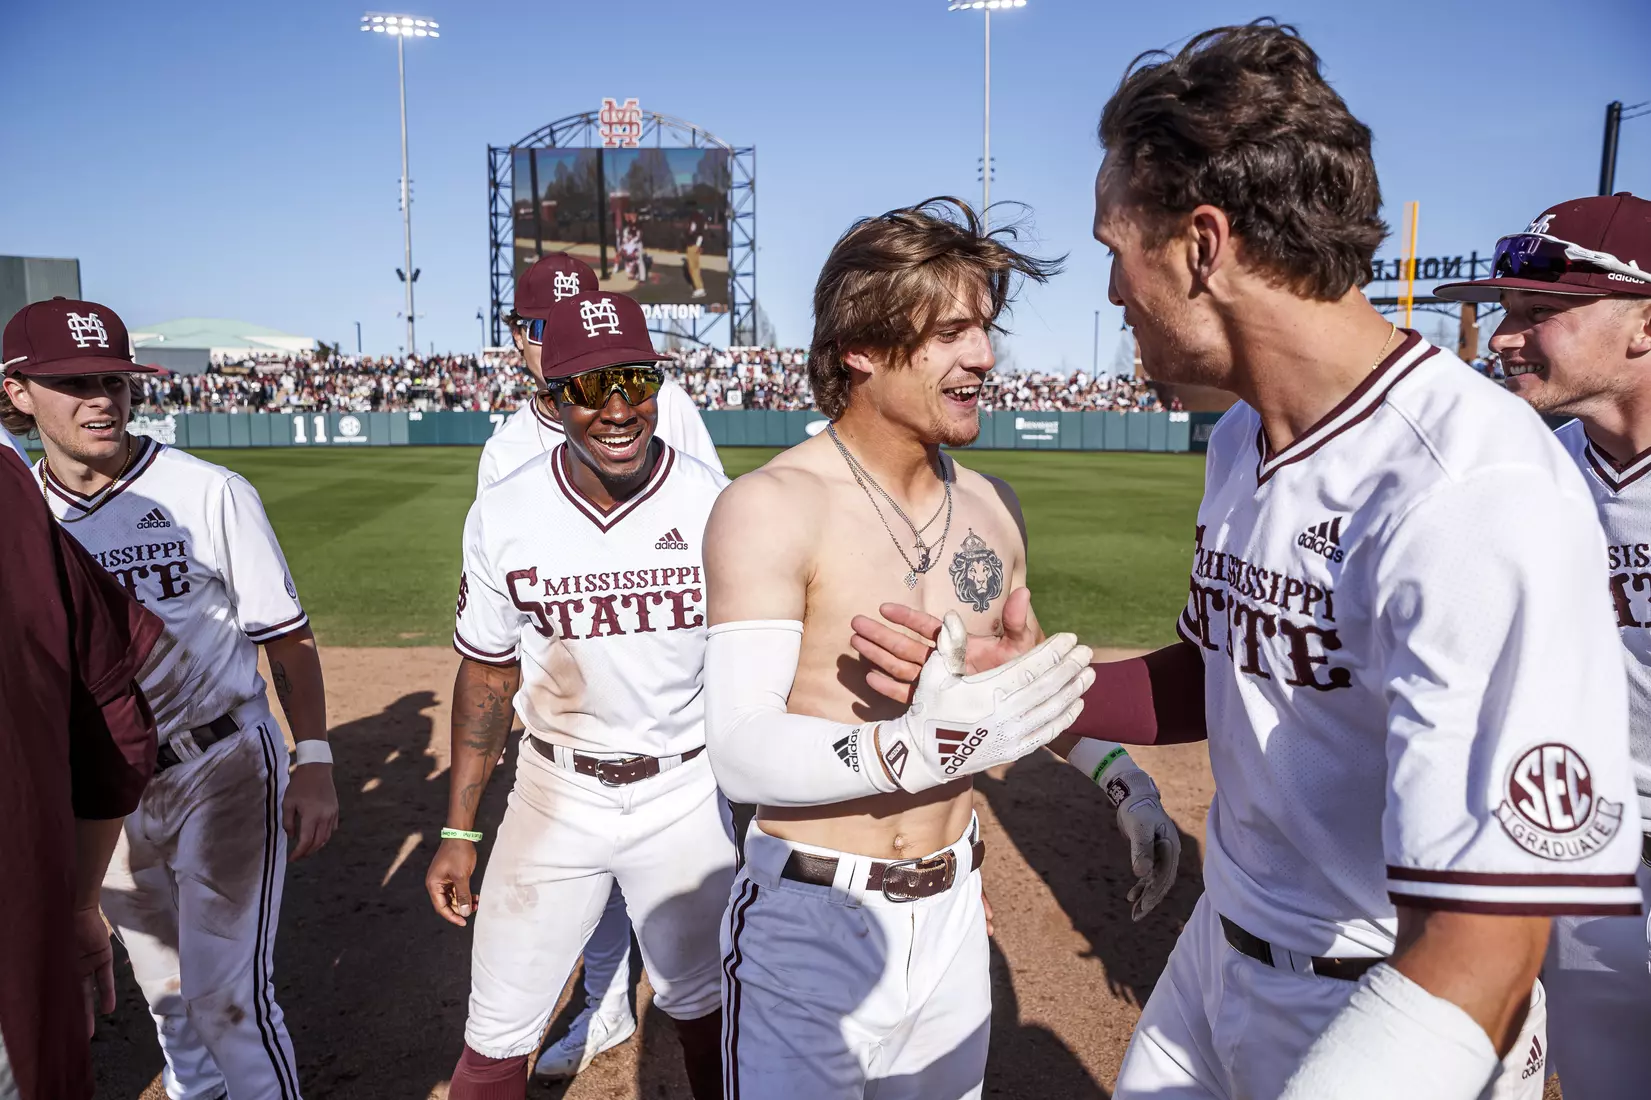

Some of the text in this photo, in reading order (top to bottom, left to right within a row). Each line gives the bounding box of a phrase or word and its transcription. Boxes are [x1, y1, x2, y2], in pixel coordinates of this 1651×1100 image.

[293, 415, 327, 443] 11
[136, 518, 171, 530] adidas
[655, 540, 689, 551] adidas
[1298, 532, 1344, 563] adidas
[543, 566, 702, 597] MISSISSIPPI
[506, 566, 704, 640] STATE
[852, 728, 860, 773] adidas
[944, 727, 989, 775] adidas
[1513, 746, 1591, 830] SEC
[1512, 822, 1612, 857] GRADUATE
